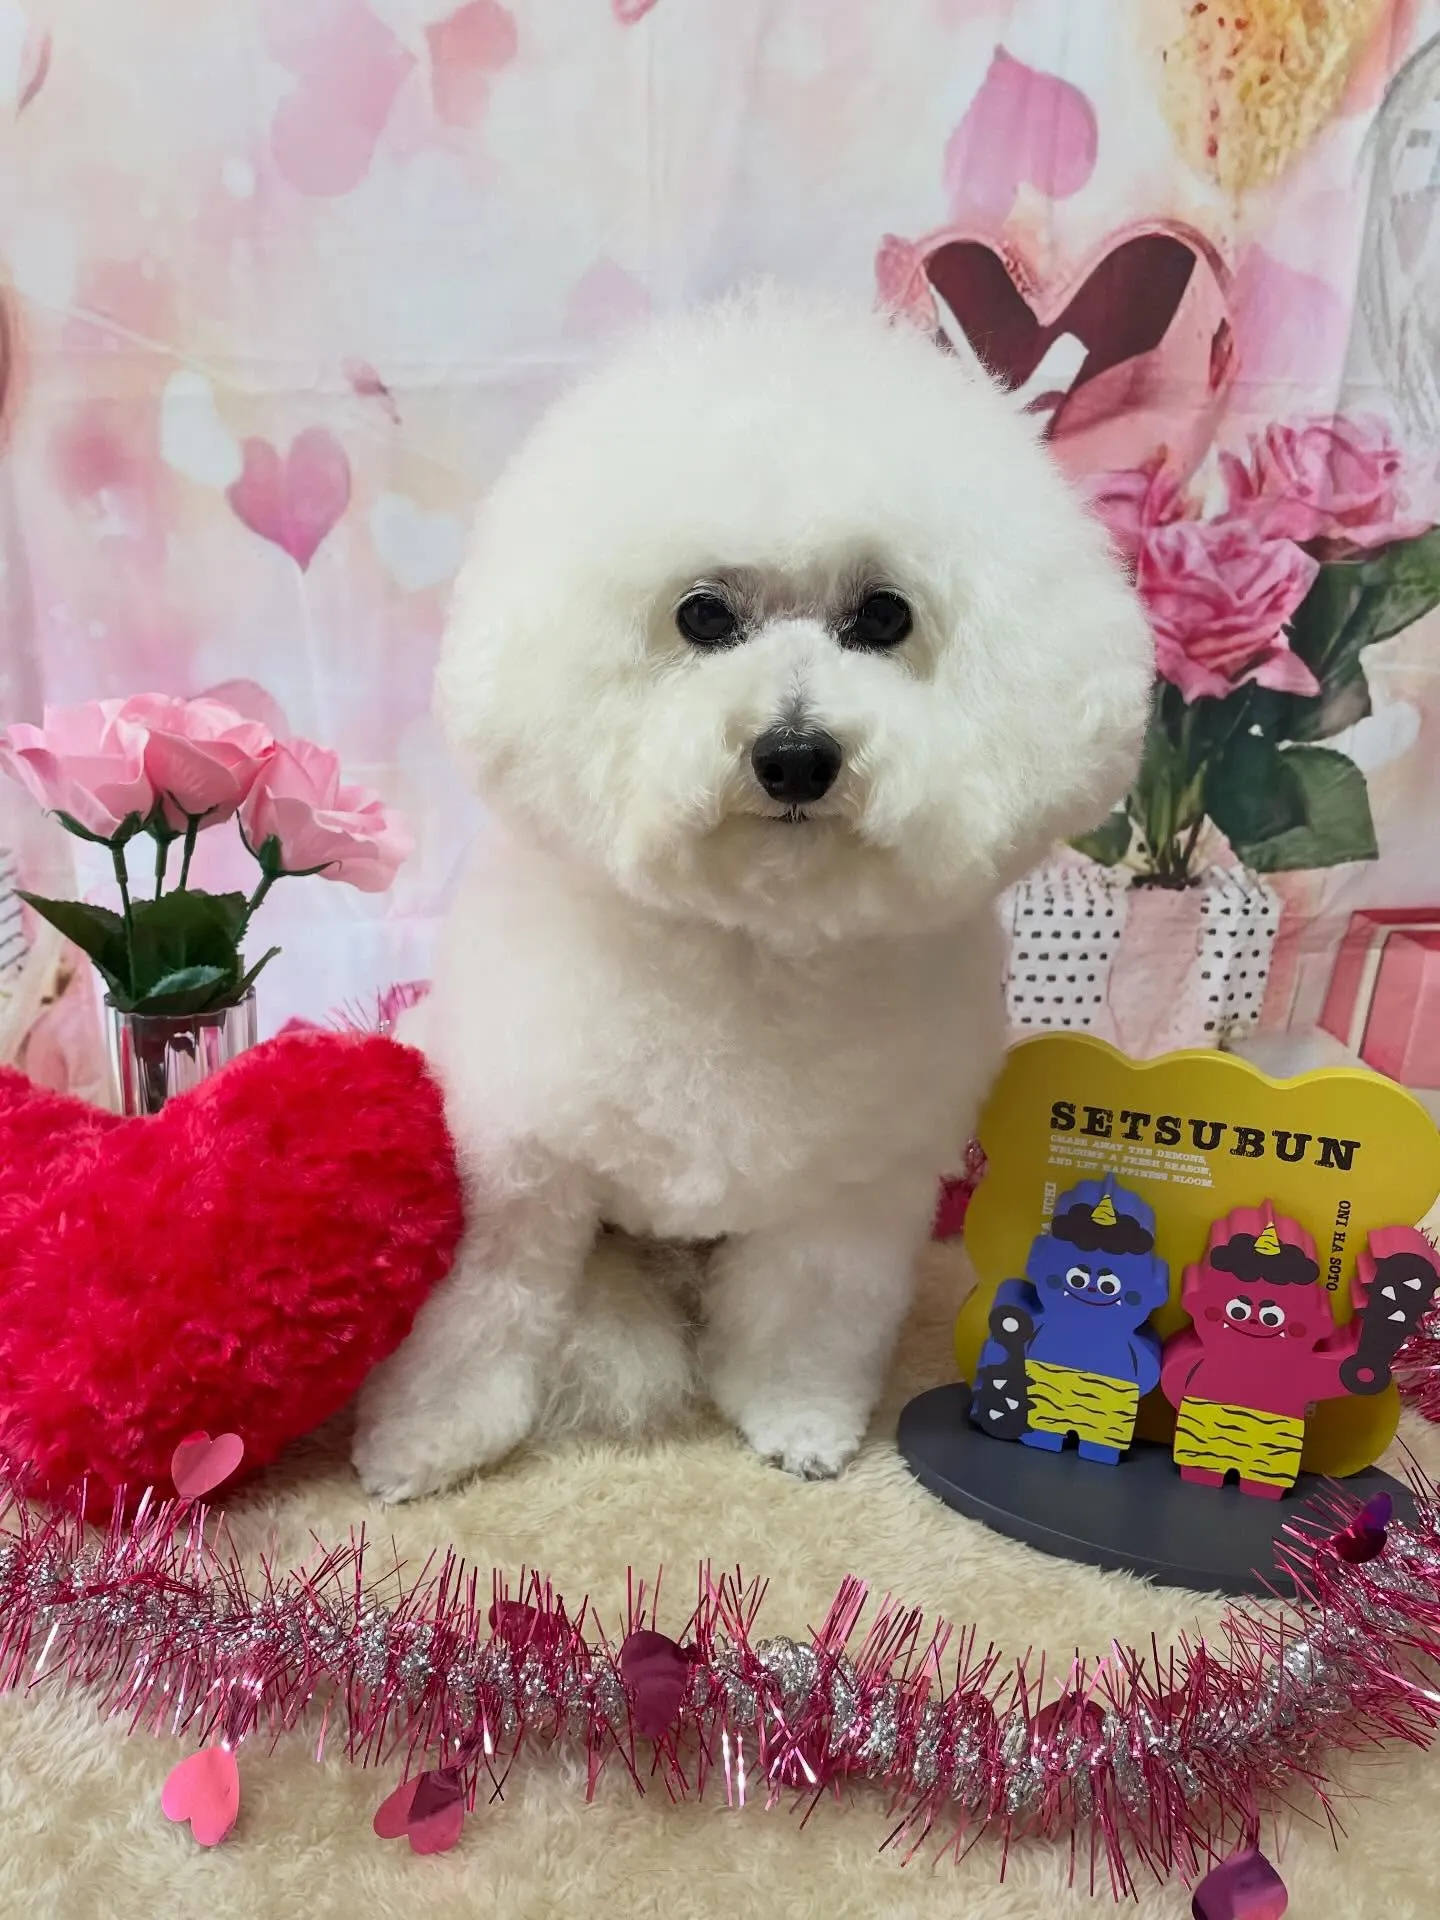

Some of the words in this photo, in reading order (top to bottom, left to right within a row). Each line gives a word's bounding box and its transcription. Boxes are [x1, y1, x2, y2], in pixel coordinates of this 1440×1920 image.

[1050, 1100, 1361, 1171] SETSUBUN
[1050, 1144, 1106, 1159] WELCOME
[1109, 1153, 1118, 1161] A
[1122, 1156, 1160, 1168] FRESH
[1164, 1161, 1212, 1177] SEASON,
[1092, 1139, 1124, 1152] AWAY
[1129, 1146, 1153, 1156] THE
[1156, 1150, 1207, 1166] DEMONS,
[1048, 1156, 1072, 1166] AND
[1076, 1160, 1098, 1169] LET
[1102, 1164, 1169, 1181] HAPPINESS
[1335, 1200, 1351, 1227] ONI
[1332, 1231, 1346, 1253] HA
[1326, 1257, 1341, 1291] SOTO
